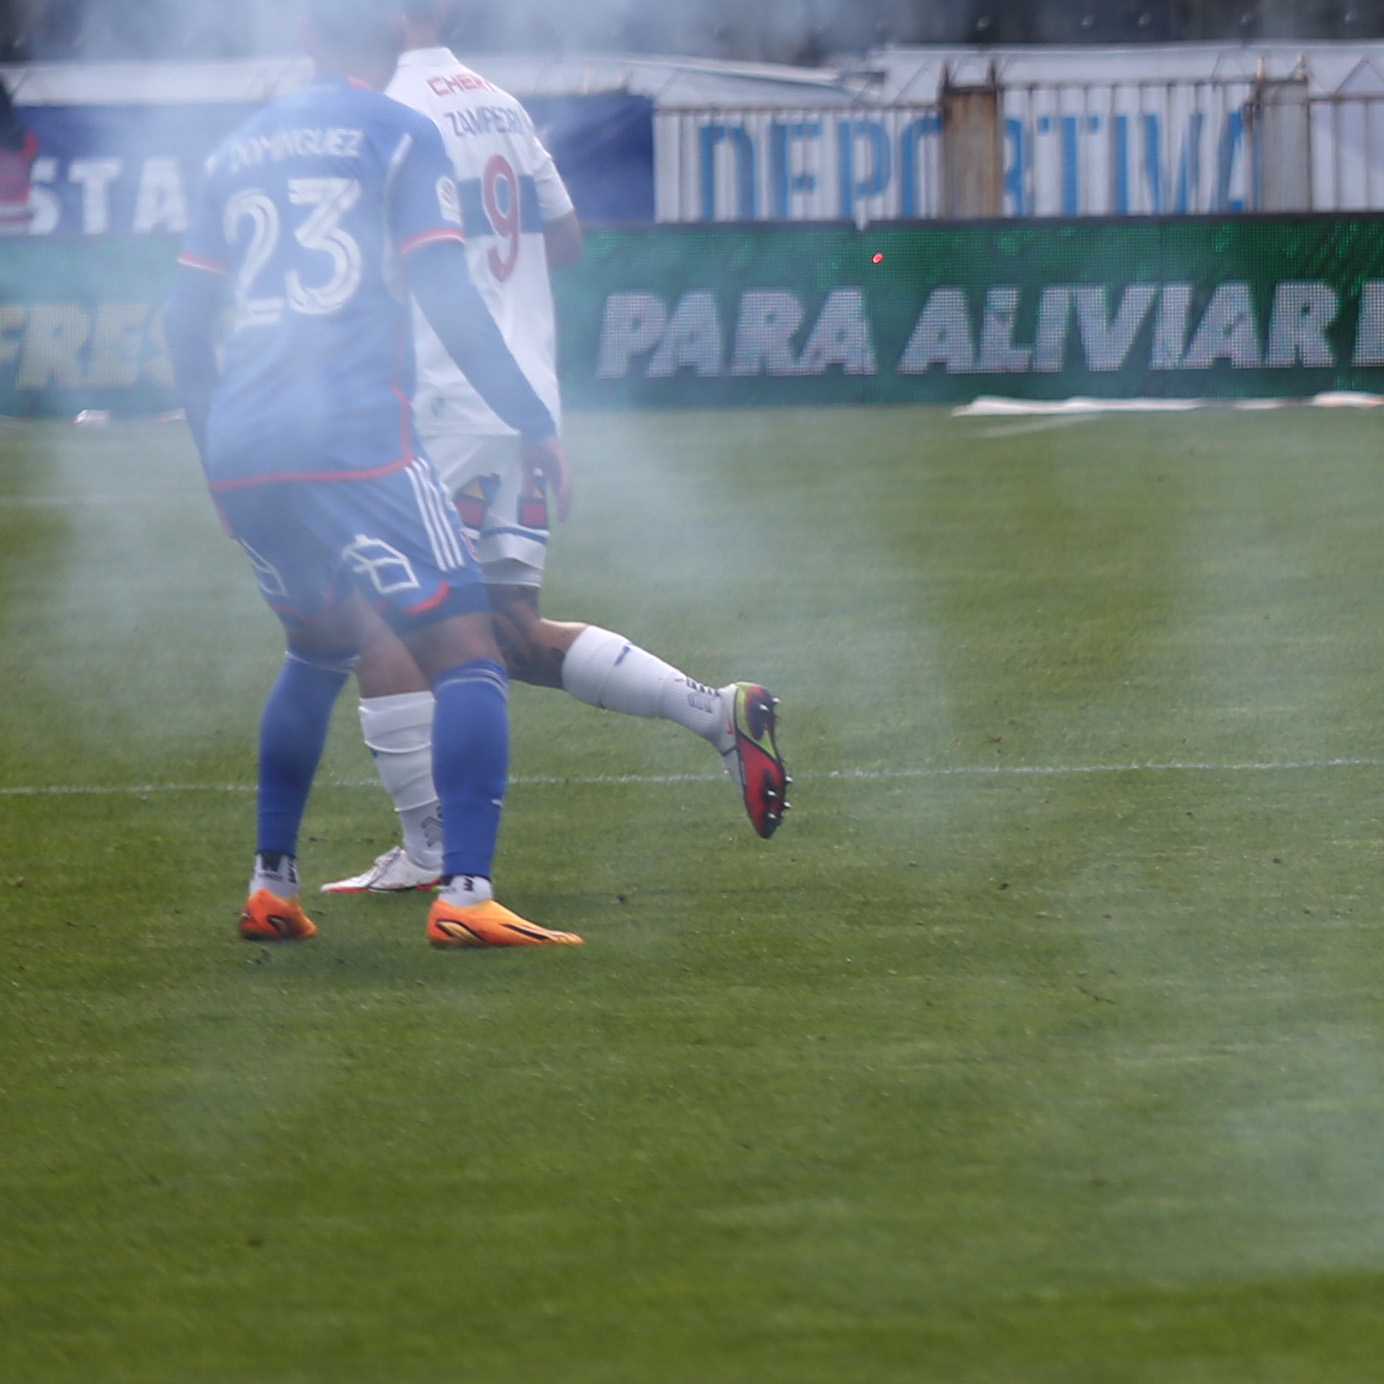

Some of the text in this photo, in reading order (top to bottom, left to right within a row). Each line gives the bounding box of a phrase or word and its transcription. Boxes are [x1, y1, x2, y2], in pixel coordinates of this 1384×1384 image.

[221, 176, 363, 334] 23
[482, 153, 520, 284] 9
[599, 285, 876, 378] PARA
[899, 280, 1340, 375] ALIVIAR
